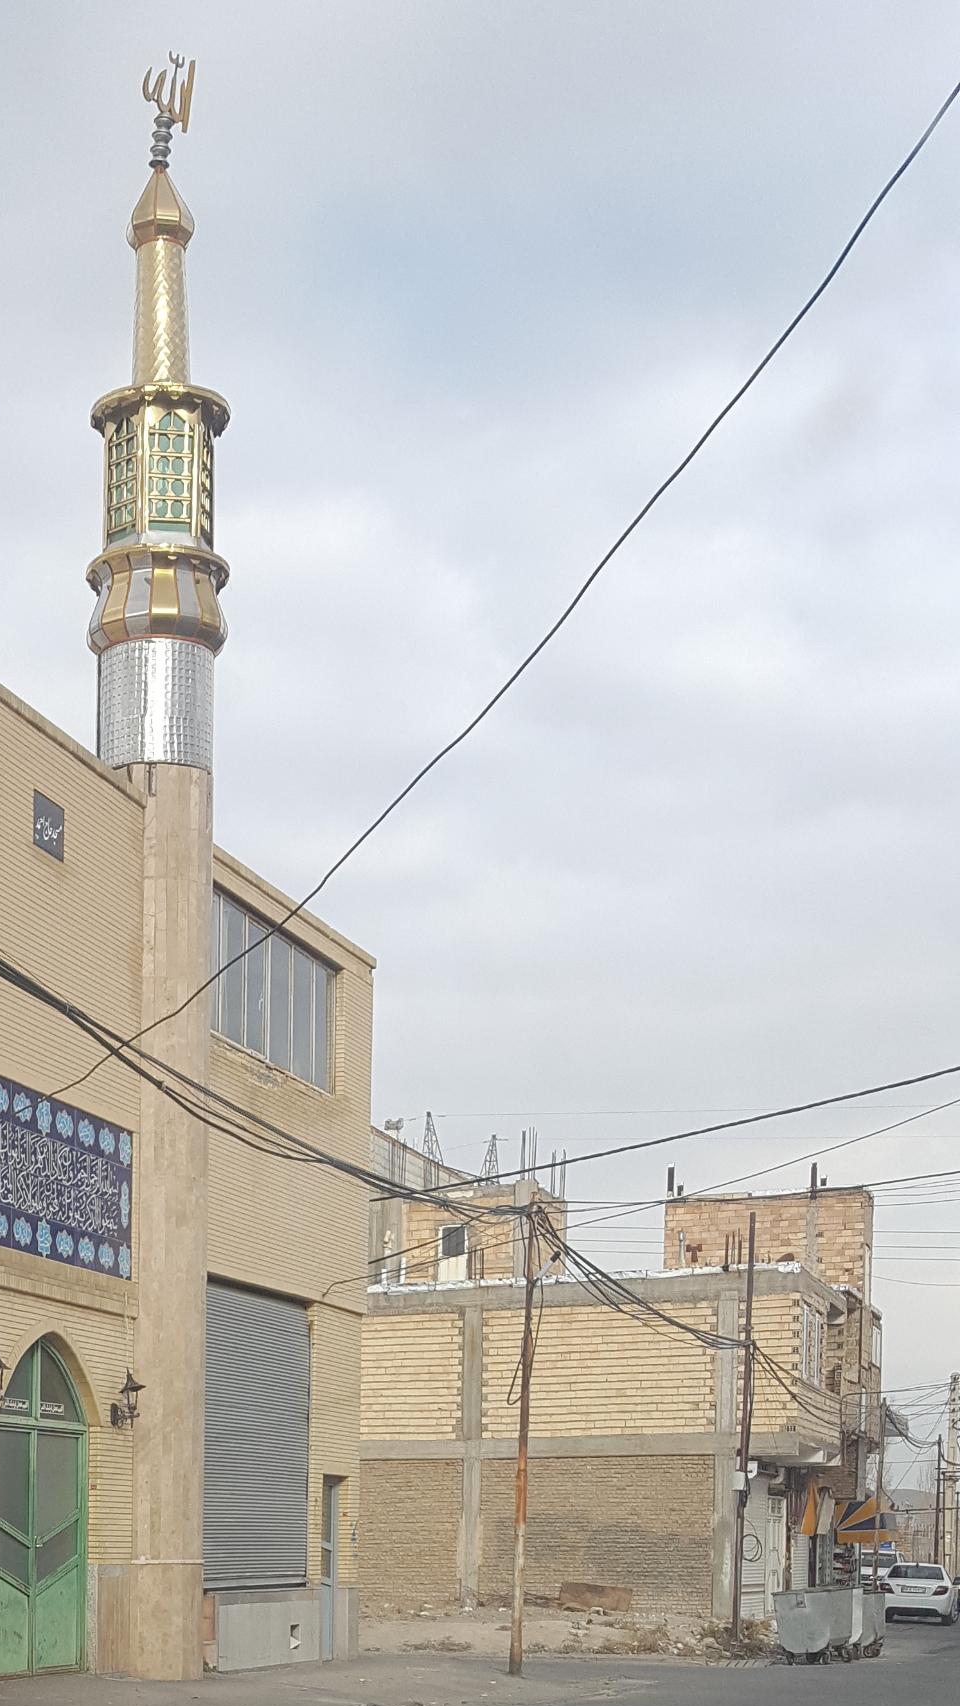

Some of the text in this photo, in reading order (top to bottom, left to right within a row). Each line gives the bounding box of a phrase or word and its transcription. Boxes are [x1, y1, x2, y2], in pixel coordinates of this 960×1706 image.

[143, 51, 196, 133] الله
[43, 818, 52, 841] حاج
[50, 825, 62, 846] مسجد
